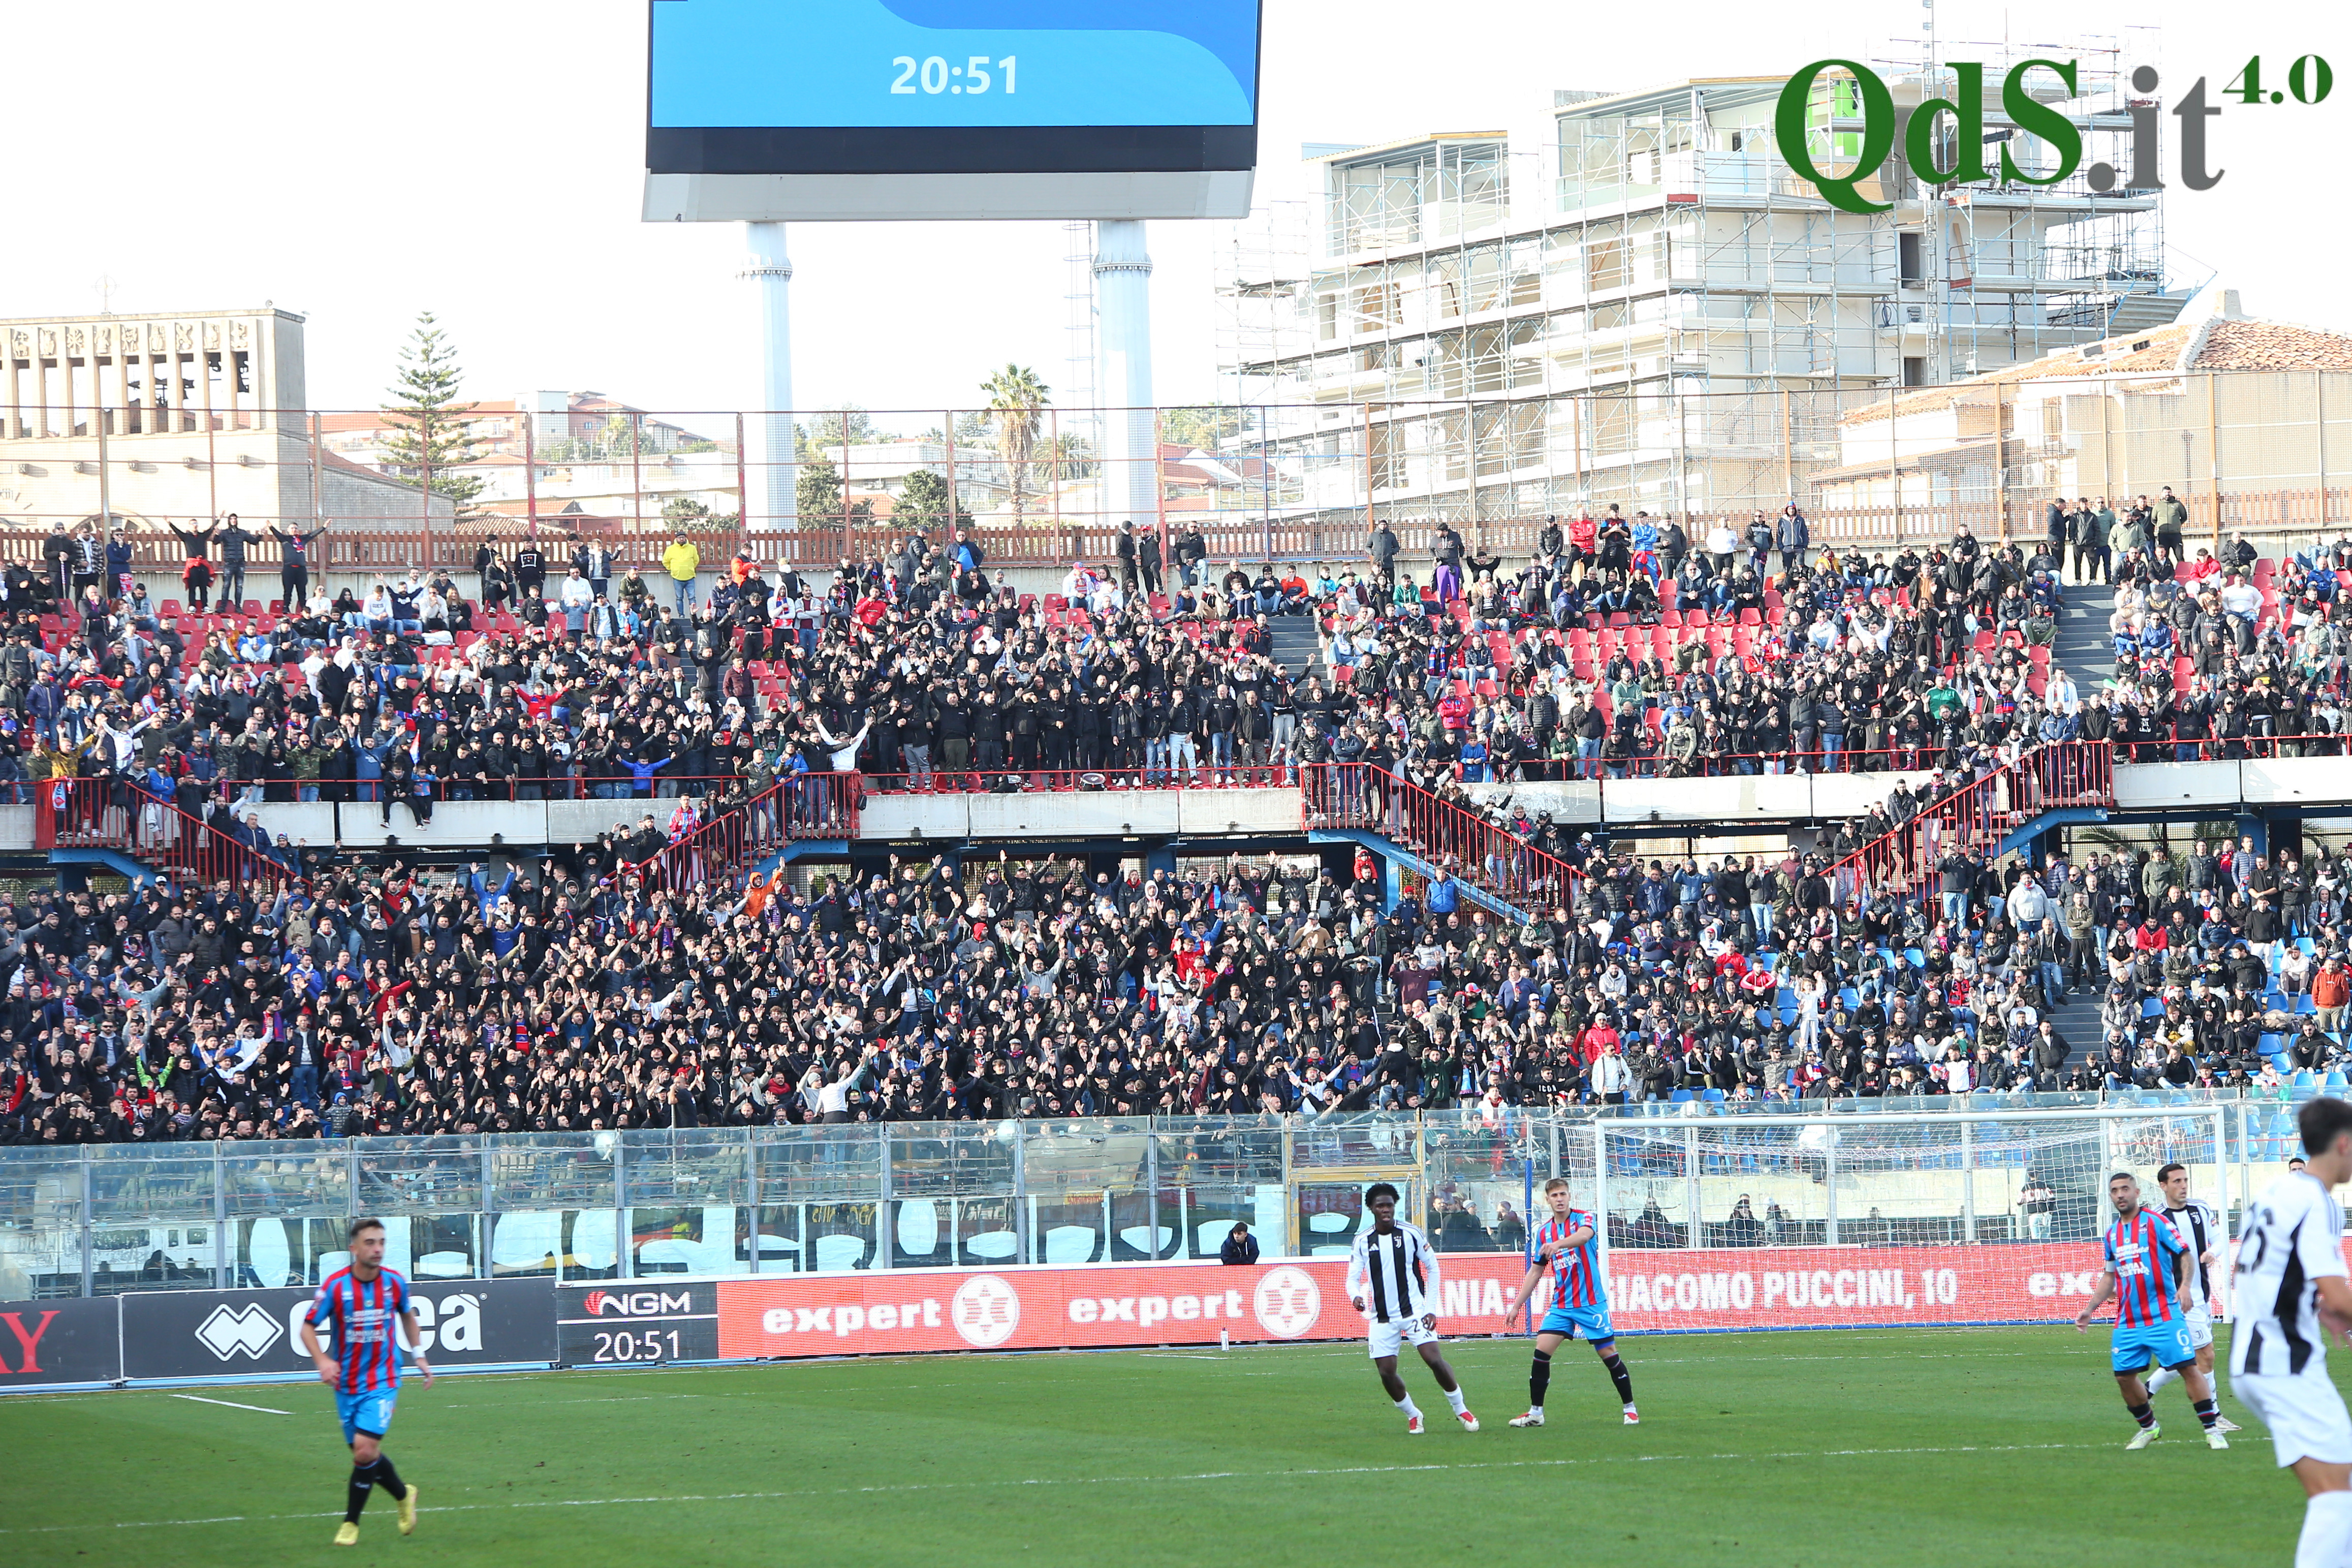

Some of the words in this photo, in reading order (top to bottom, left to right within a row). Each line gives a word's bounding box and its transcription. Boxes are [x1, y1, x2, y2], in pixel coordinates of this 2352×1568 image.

[890, 55, 1018, 95] 20:51
[1539, 1084, 1557, 1092] ICON
[599, 1291, 691, 1315] NGM
[1068, 1290, 1244, 1327] expert
[1609, 1270, 1753, 1313] IACOMO
[1764, 1268, 1914, 1310] PUCCINI,
[1922, 1268, 1958, 1305] 10
[763, 1298, 942, 1336] expert
[0, 1310, 61, 1374] Y
[594, 1329, 680, 1362] 20:51
[2176, 1328, 2190, 1346] 6
